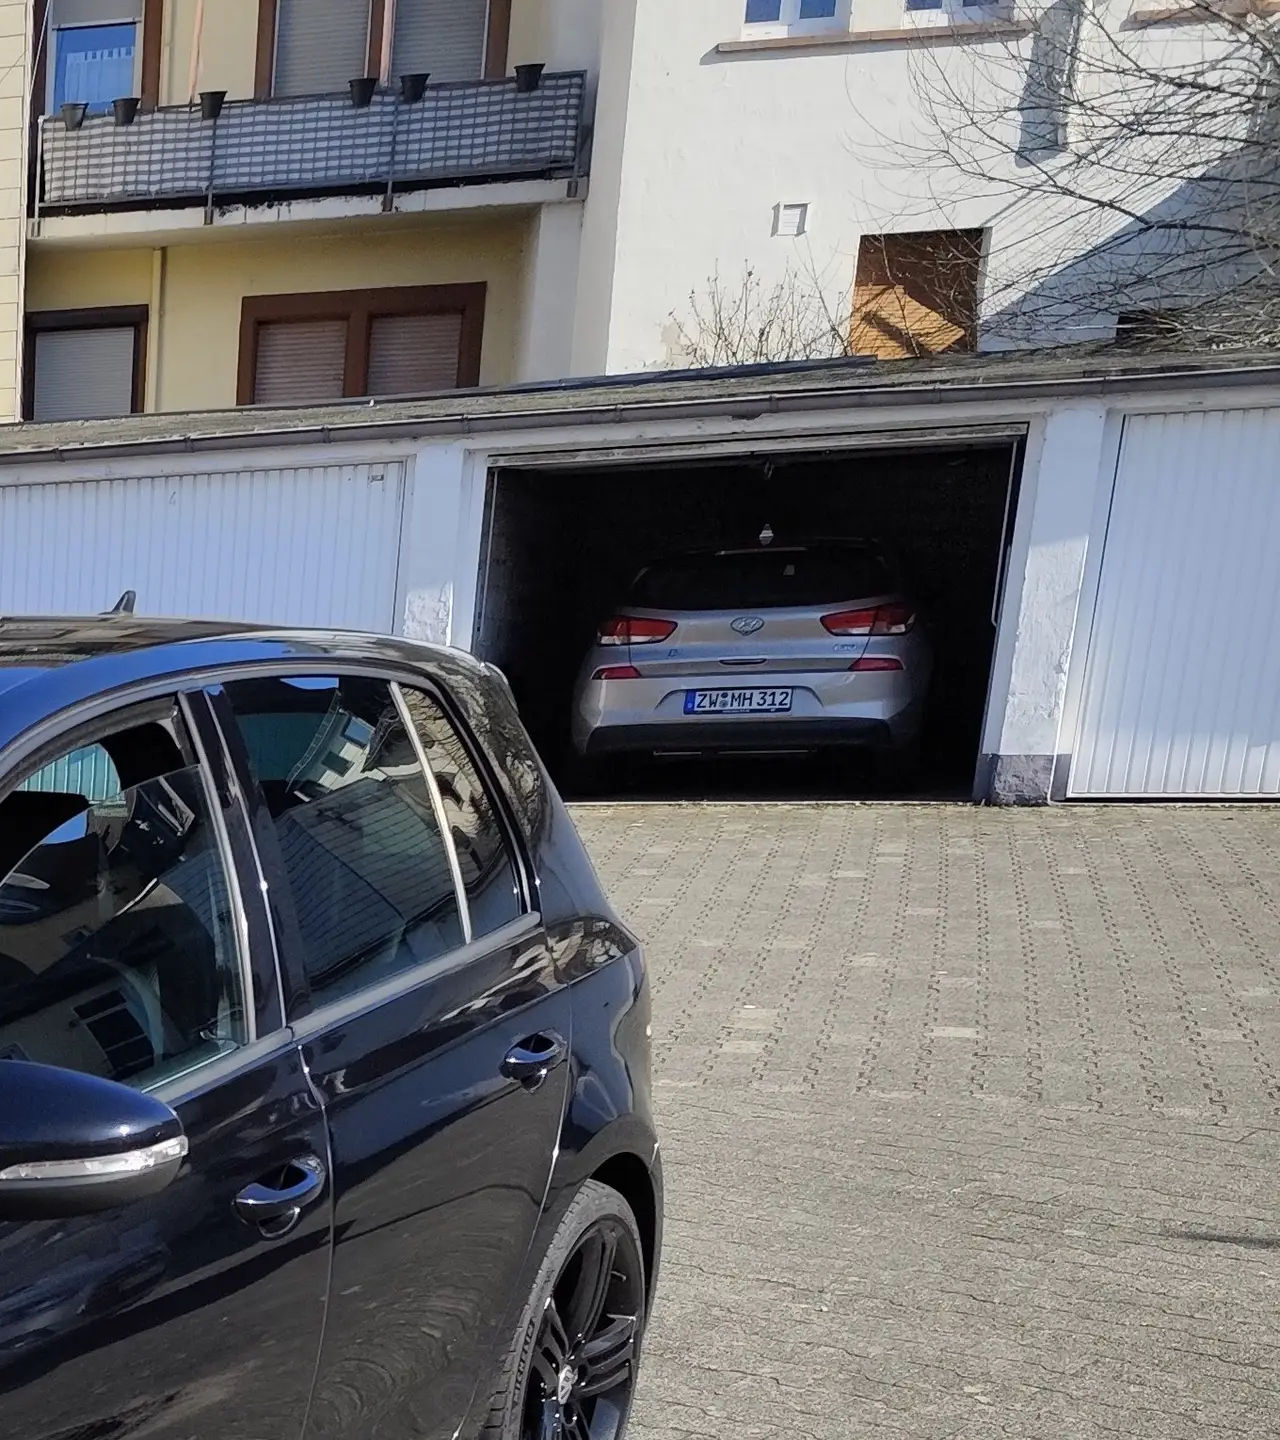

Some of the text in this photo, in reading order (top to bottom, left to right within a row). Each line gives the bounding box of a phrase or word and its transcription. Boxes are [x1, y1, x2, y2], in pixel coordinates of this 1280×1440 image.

[696, 691, 789, 708] ZW MH 312
